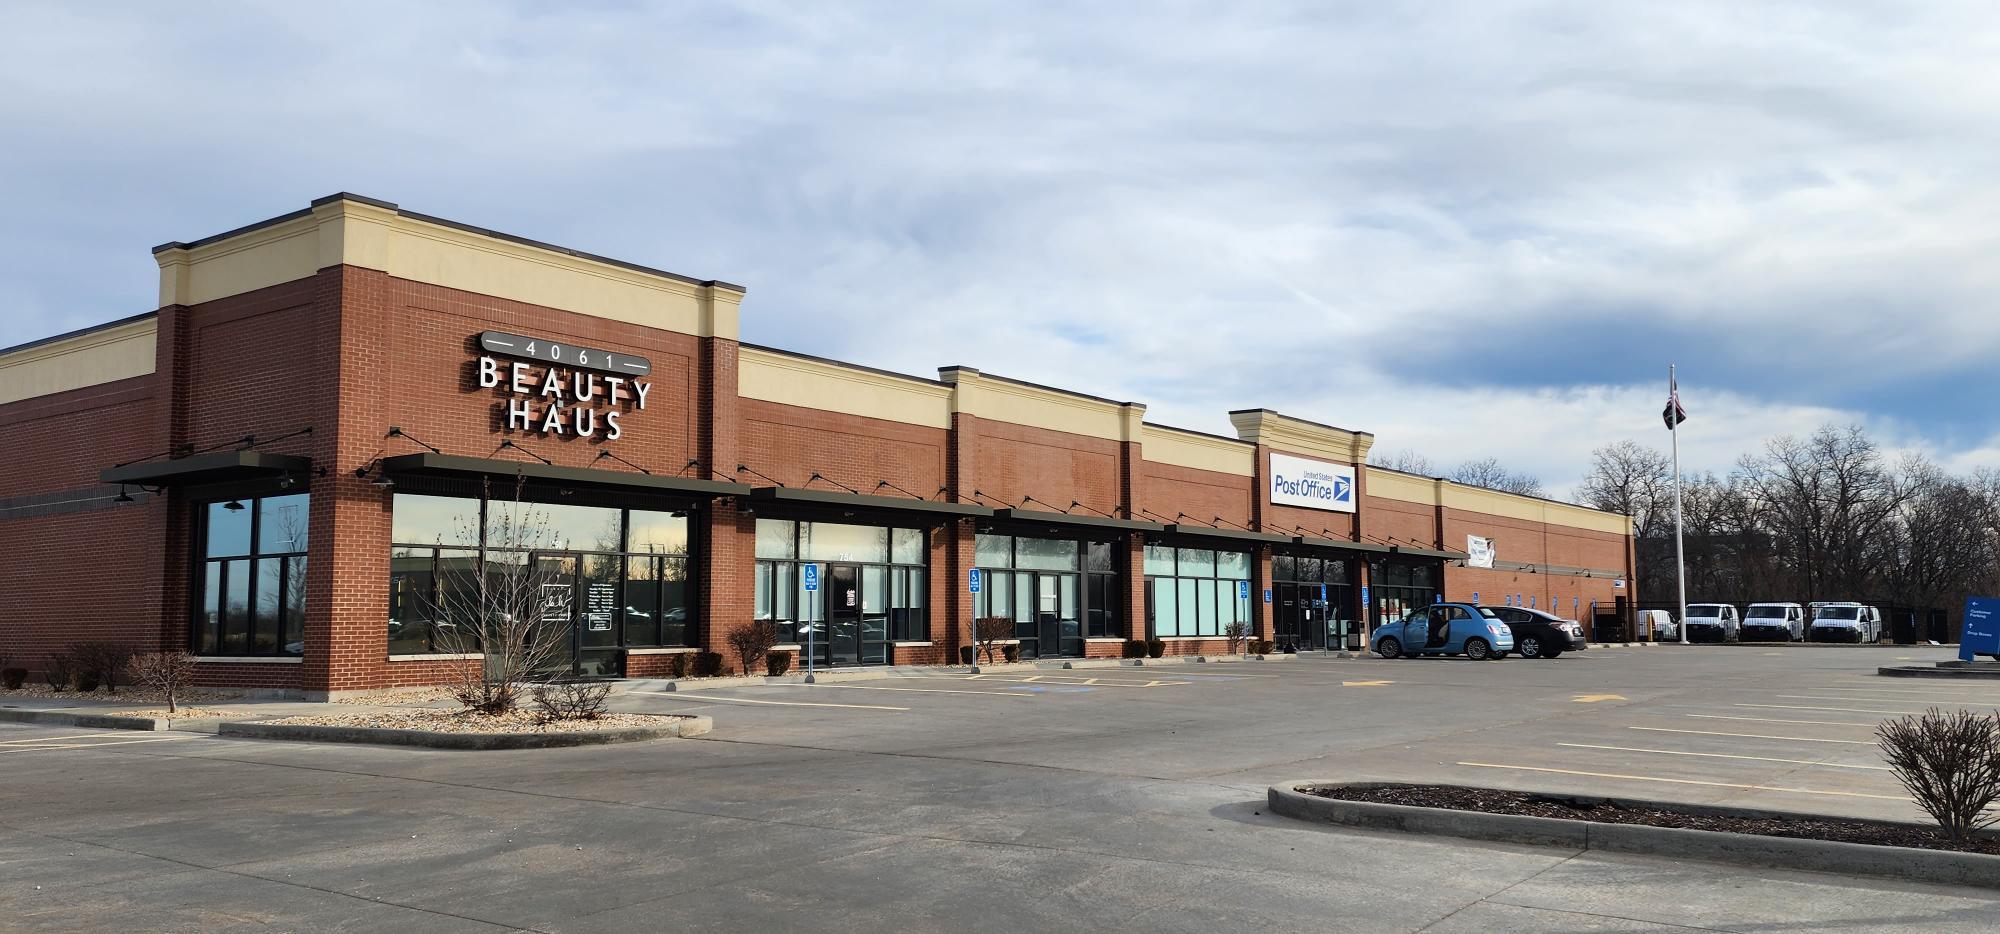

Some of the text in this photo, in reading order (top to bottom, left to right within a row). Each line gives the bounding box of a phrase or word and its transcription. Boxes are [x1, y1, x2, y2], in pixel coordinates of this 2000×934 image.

[526, 341, 613, 369] 4061
[479, 356, 651, 410] BEAUTY
[509, 398, 621, 440] HAUS
[1274, 474, 1332, 500] Post Office
[1303, 470, 1333, 482] United States
